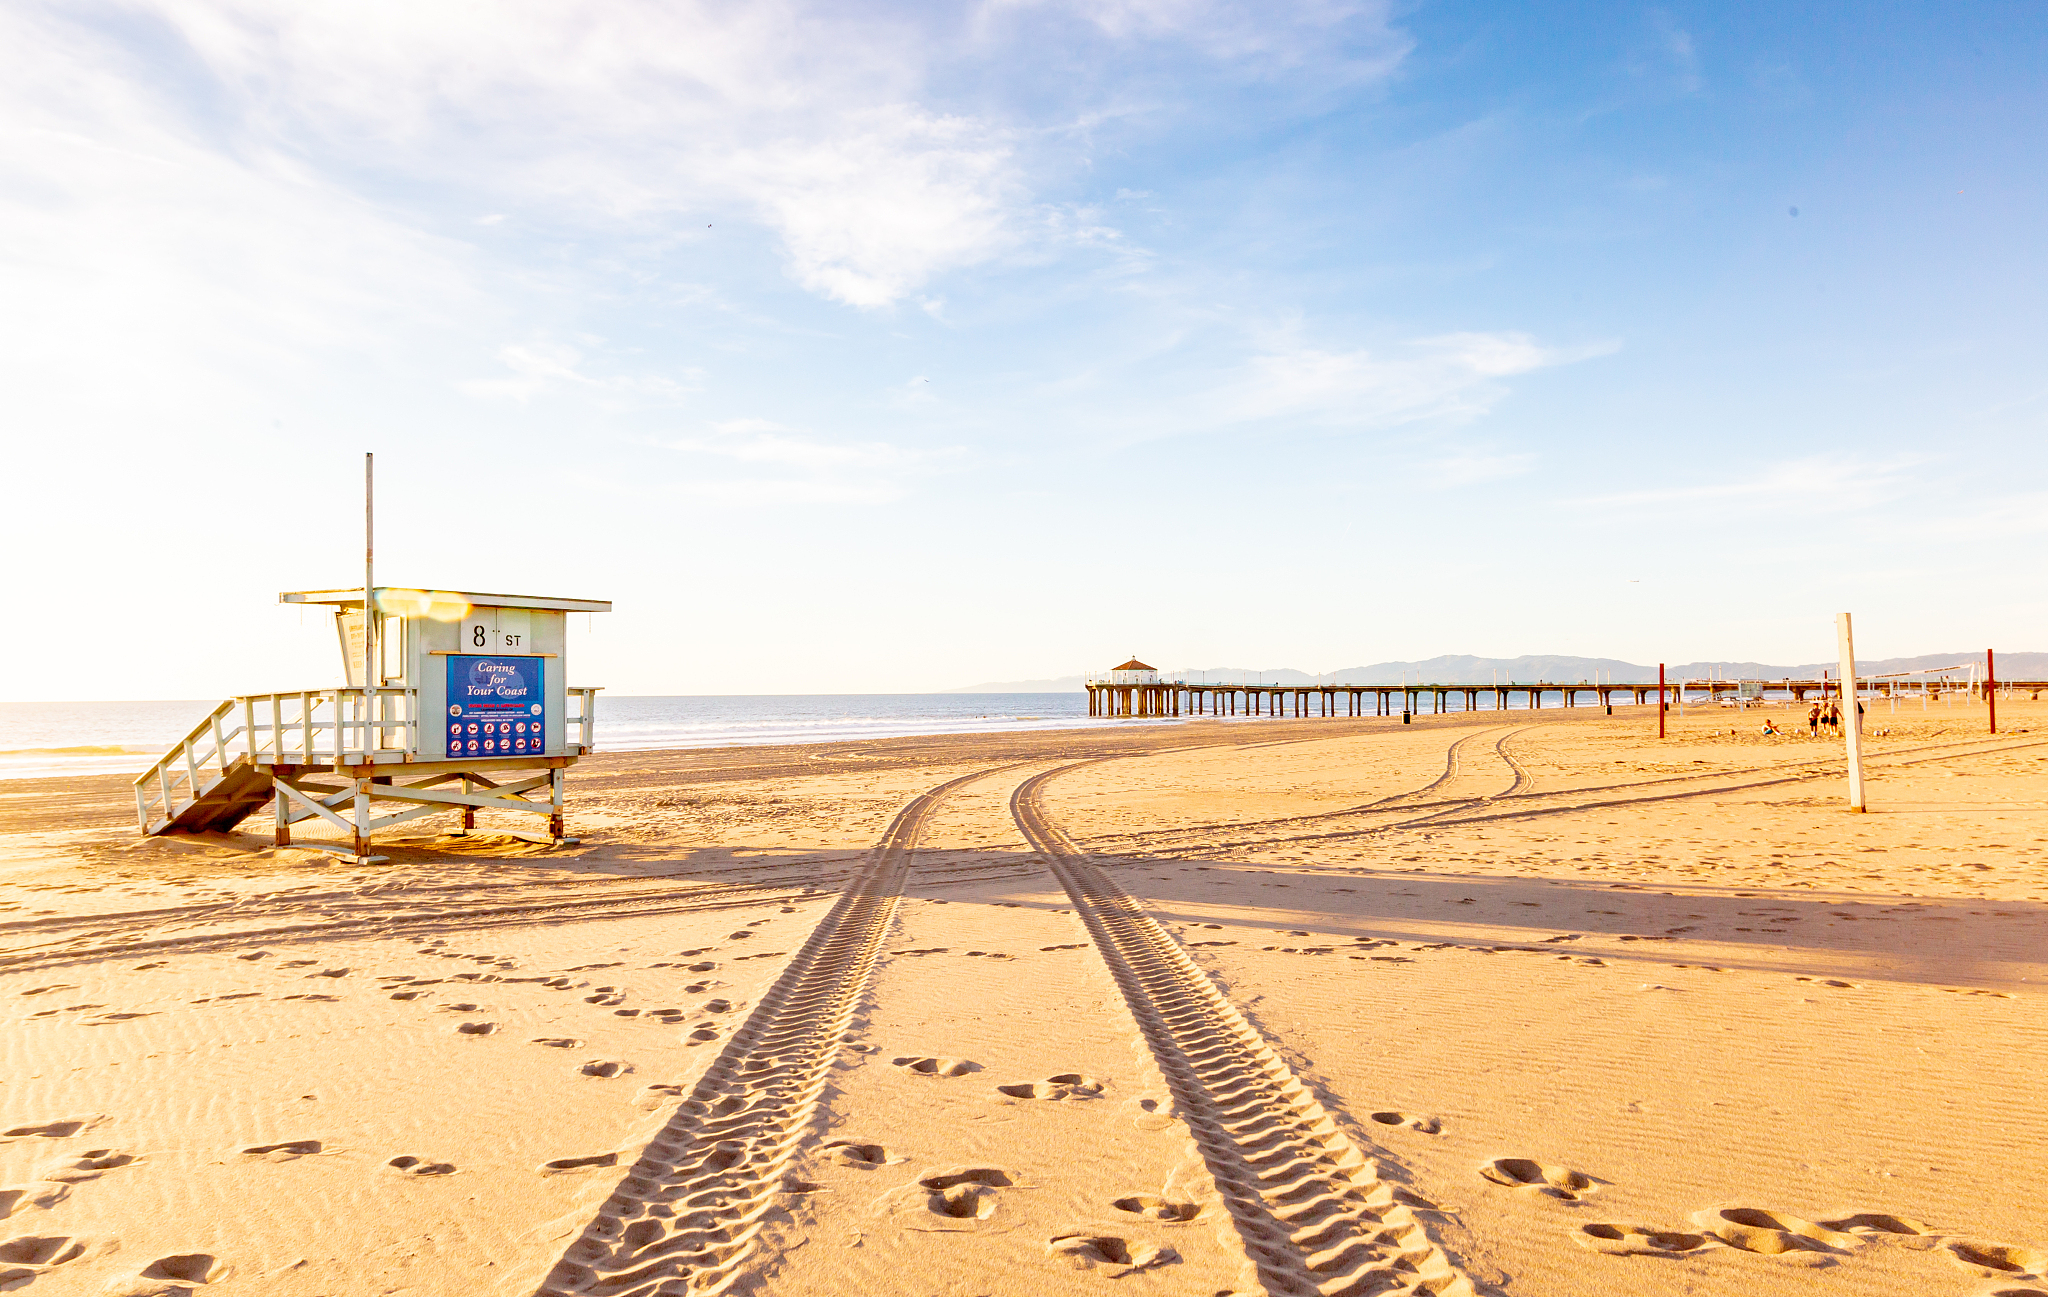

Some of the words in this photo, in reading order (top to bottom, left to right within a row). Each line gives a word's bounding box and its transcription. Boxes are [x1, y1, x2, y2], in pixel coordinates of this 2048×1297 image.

[473, 625, 486, 647] 8
[505, 635, 522, 647] ST
[477, 662, 516, 676] Caring
[487, 674, 507, 687] for
[467, 685, 494, 696] Your
[496, 685, 528, 696] Coast
